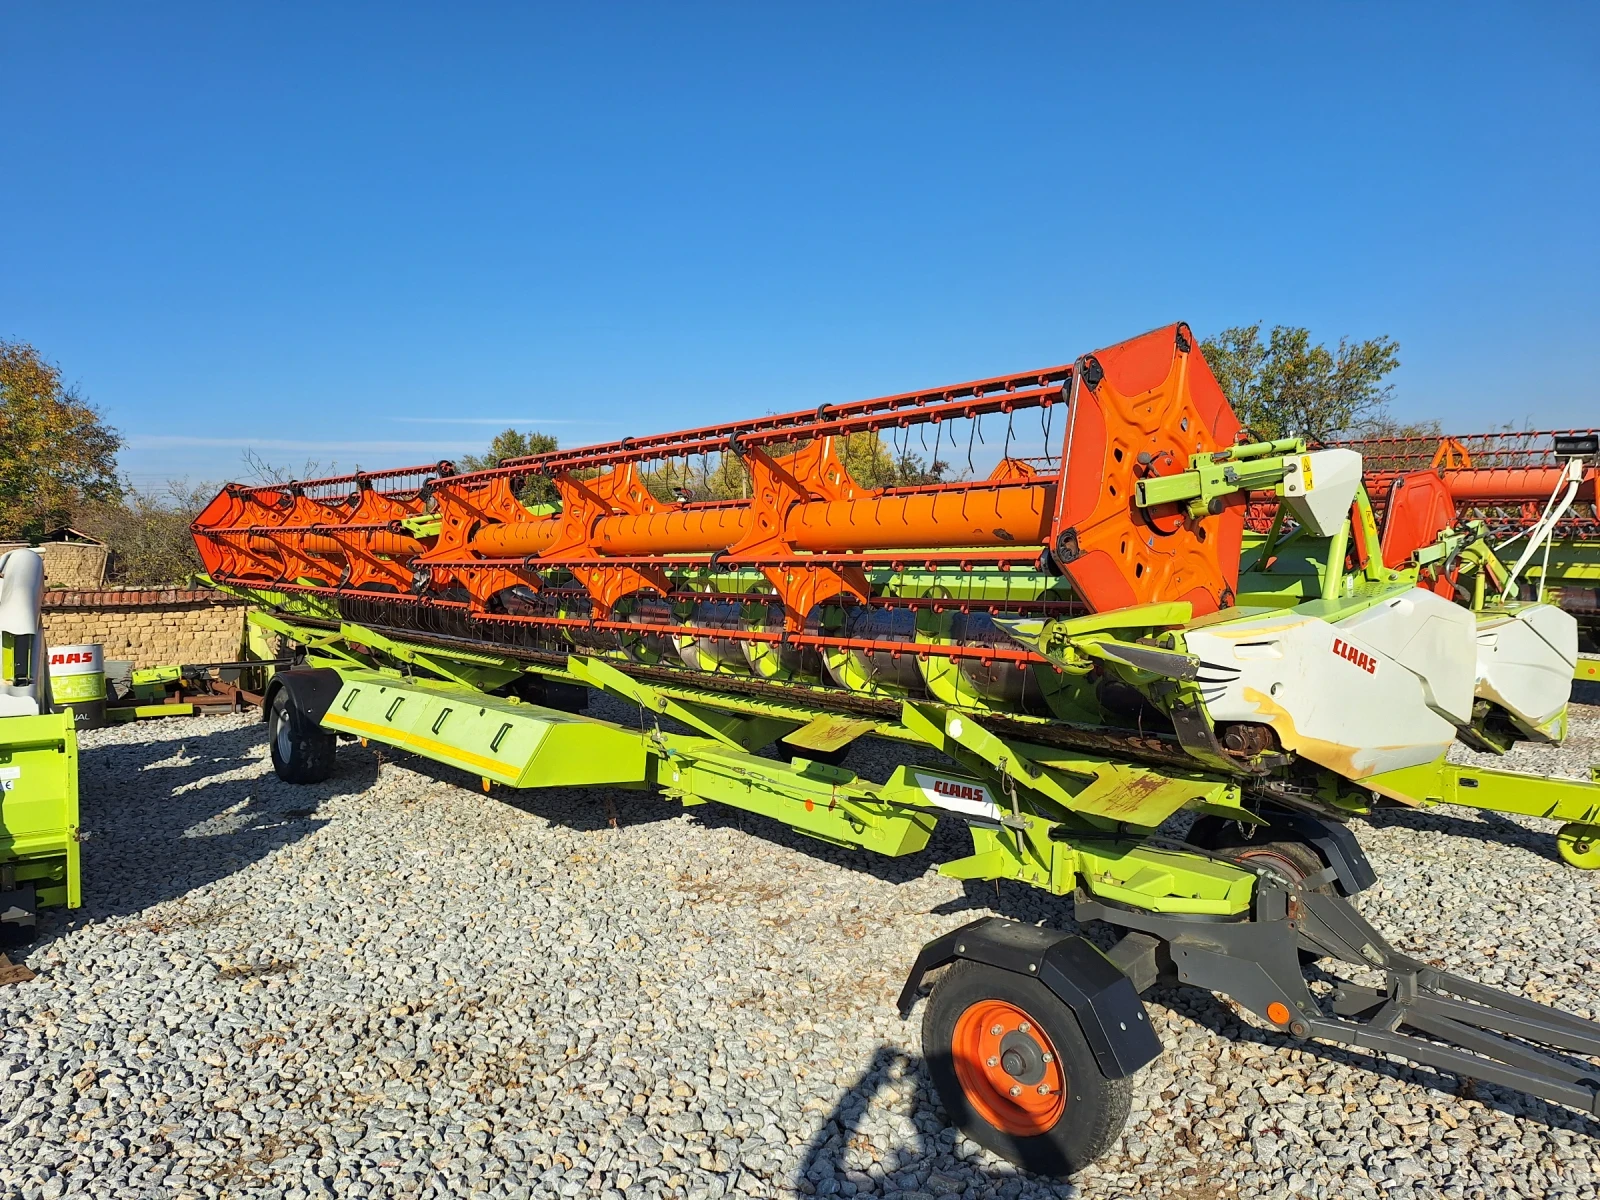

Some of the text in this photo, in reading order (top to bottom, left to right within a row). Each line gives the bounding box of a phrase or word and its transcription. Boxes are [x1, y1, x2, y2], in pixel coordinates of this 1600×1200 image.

[48, 652, 93, 665] AAS
[1332, 638, 1377, 675] CLAAS
[933, 780, 984, 802] CLAAS
